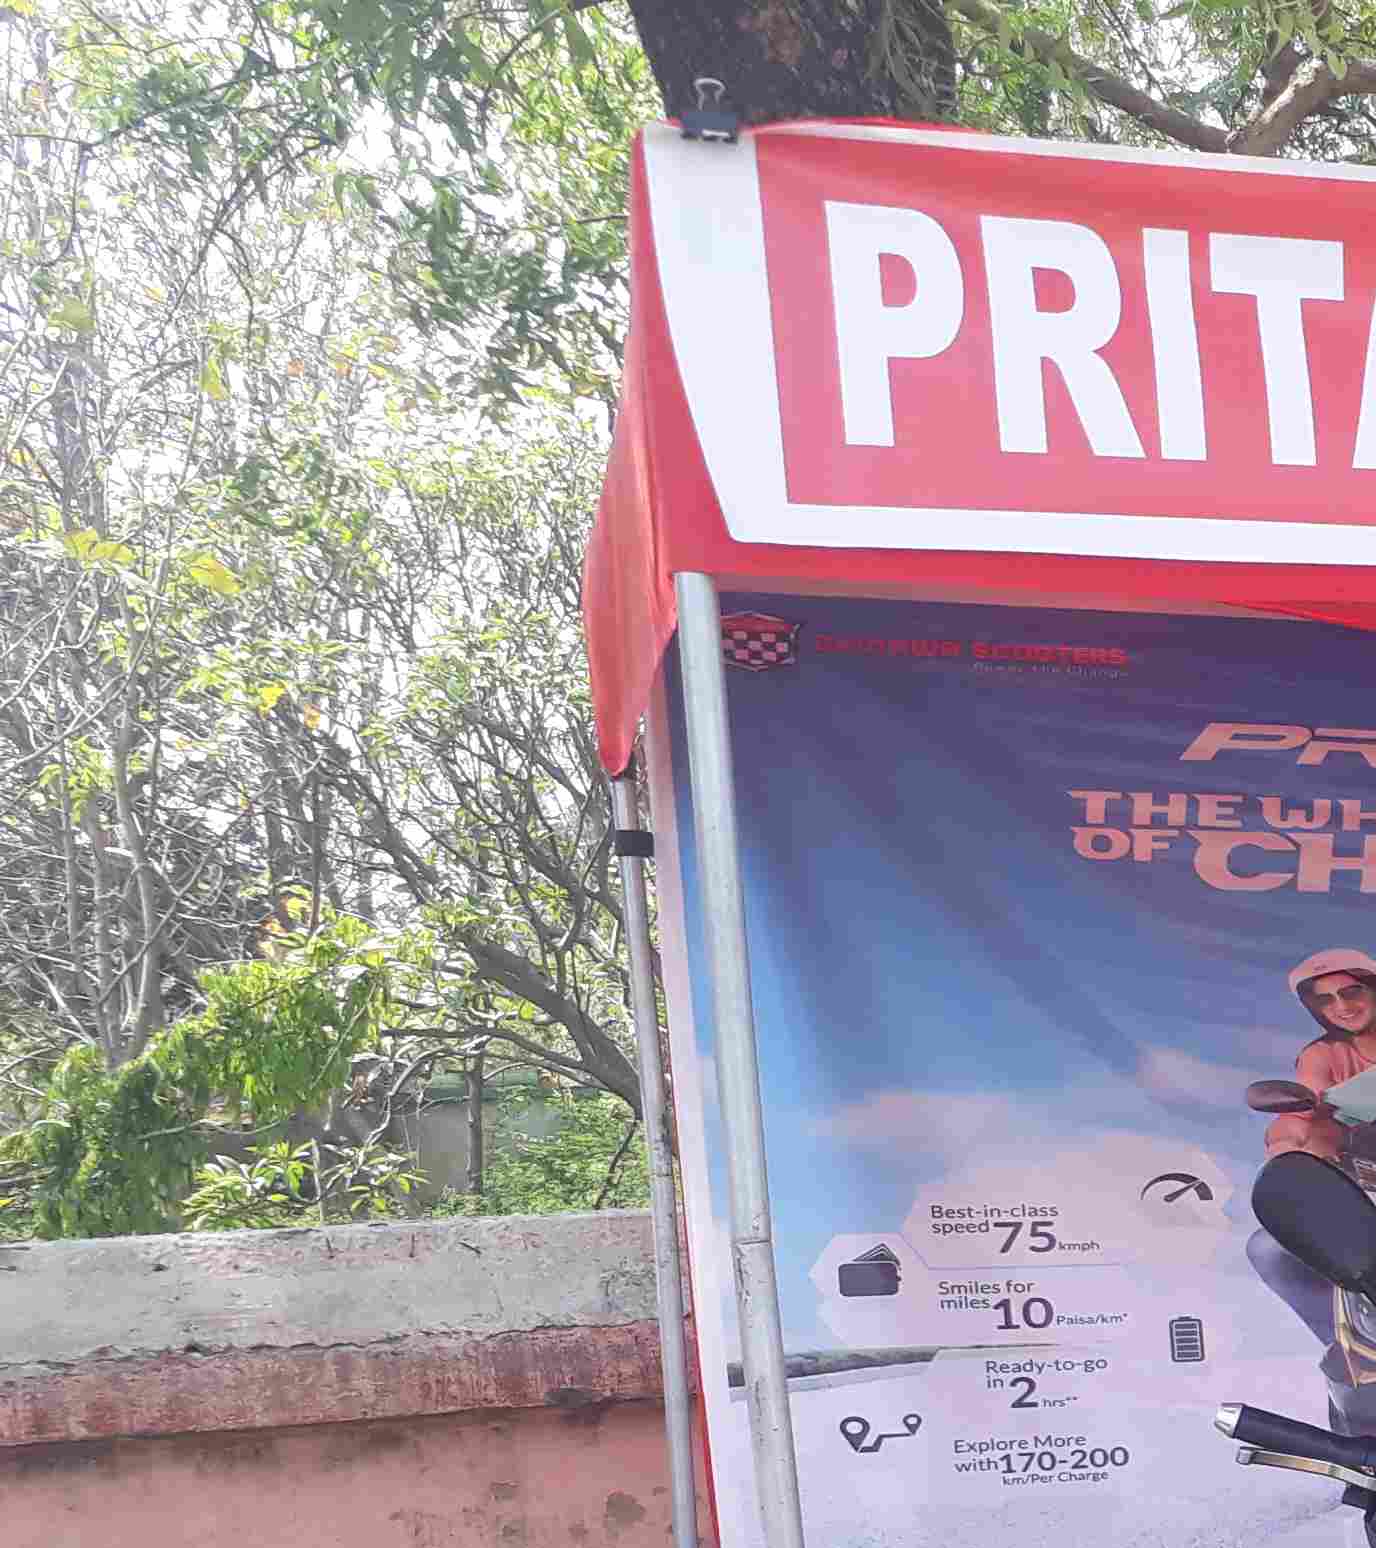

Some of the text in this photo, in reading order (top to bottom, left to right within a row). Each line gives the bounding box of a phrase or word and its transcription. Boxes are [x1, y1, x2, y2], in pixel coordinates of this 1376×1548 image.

[1068, 791, 1244, 829] THE
[1070, 826, 1180, 862] OF
[930, 1204, 1060, 1220] Best-in-class
[931, 1220, 1100, 1254] speed 75 kmph
[938, 1279, 1036, 1296] Smiles for
[940, 1296, 991, 1311] miles
[992, 1298, 1054, 1331] 10
[985, 1356, 1108, 1376] Ready-to-go
[985, 1376, 1005, 1390] in
[1009, 1376, 1039, 1409] 2
[954, 1433, 1087, 1454] Explore More
[954, 1446, 1130, 1474] with 170-200
[1058, 1469, 1109, 1484] Charge
